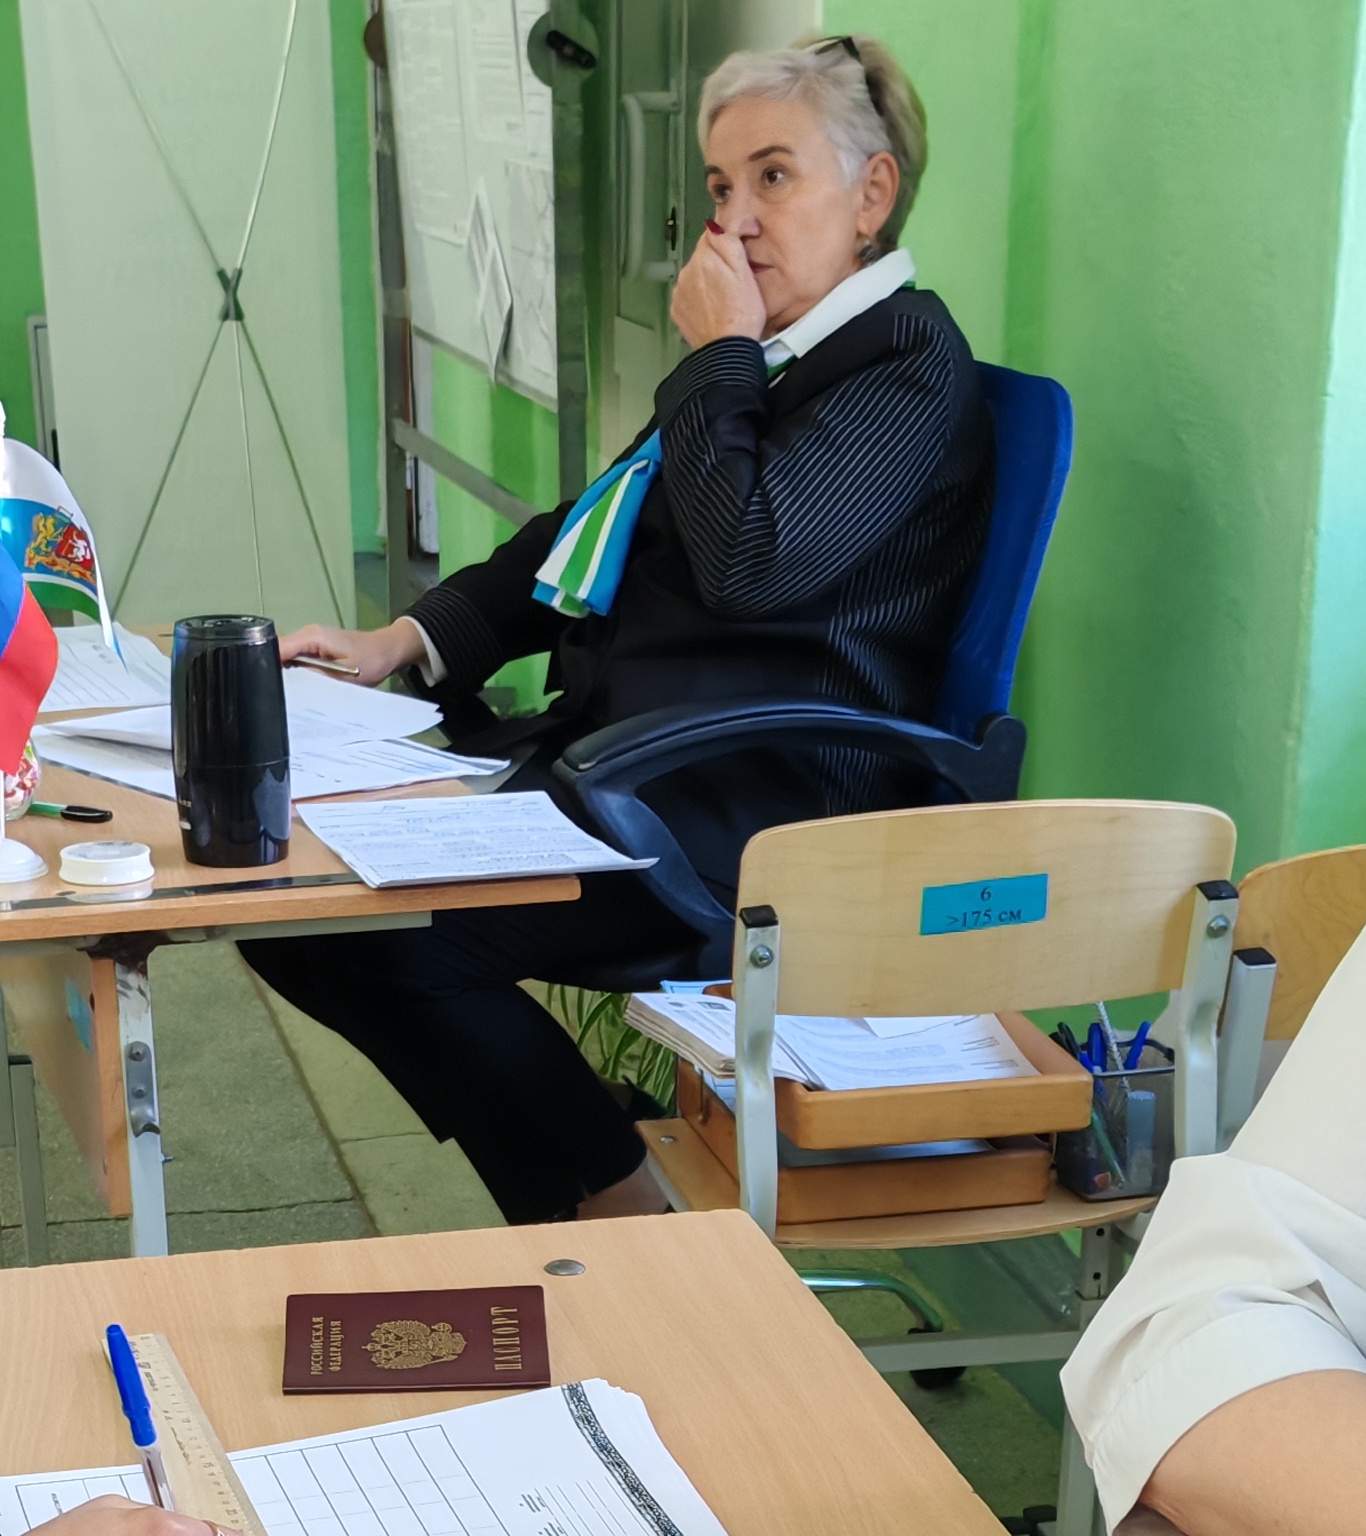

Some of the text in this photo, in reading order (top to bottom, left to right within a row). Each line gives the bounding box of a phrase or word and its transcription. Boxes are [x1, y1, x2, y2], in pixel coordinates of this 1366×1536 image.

[946, 910, 1022, 927] >175 см
[980, 885, 992, 901] 6
[310, 1315, 324, 1376] РОССИЙСКАЯ
[329, 1319, 343, 1373] ФЕДЕРАЦИЯ
[494, 1305, 519, 1372] ПАСПОРТ
